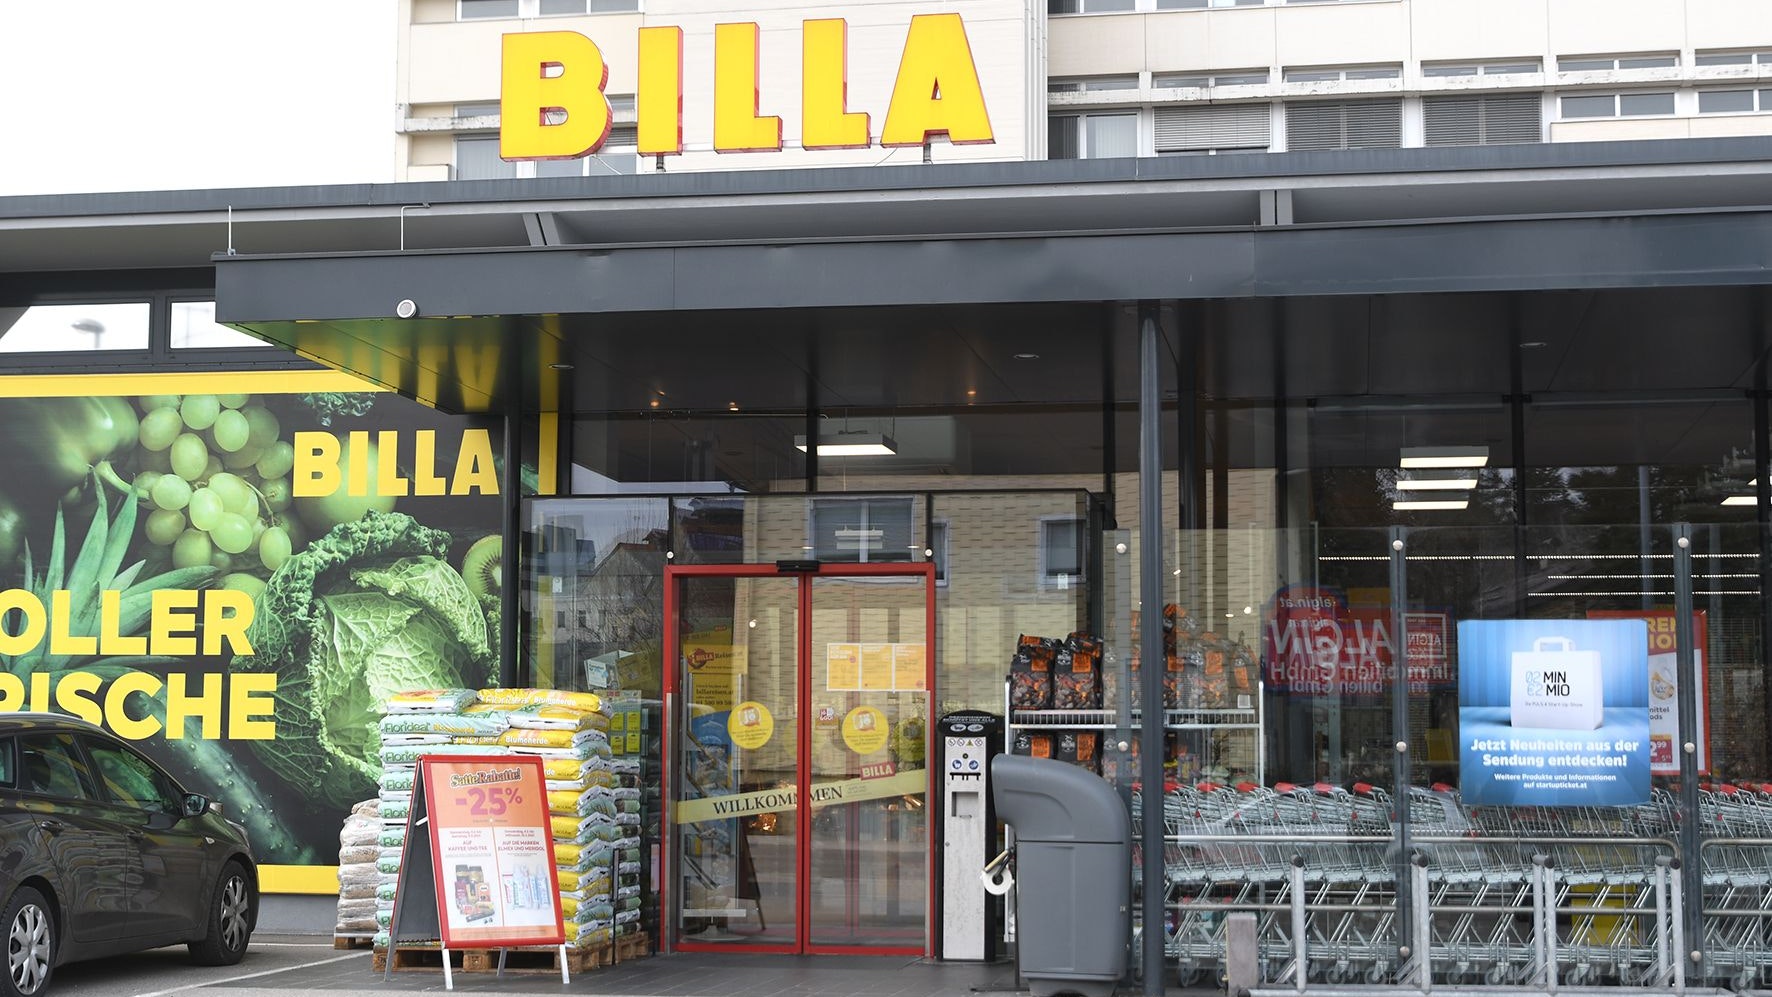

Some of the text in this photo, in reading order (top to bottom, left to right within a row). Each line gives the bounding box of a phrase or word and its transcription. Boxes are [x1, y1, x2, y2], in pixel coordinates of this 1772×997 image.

[500, 13, 996, 162] BILLA
[293, 429, 500, 497] BILLA
[0, 588, 256, 656] OLLER
[1543, 671, 1567, 684] MIN
[1546, 683, 1570, 697] MIO
[384, 721, 430, 733] Florideal
[1471, 738, 1639, 752] Jetzt Neuheiten aus der
[1483, 753, 1627, 767] Sendung entdecken!
[861, 762, 893, 778] BILLA
[1494, 773, 1521, 781] Weitere
[1522, 773, 1551, 781] Produkte
[1523, 781, 1535, 789] auf
[455, 787, 523, 816] -25%
